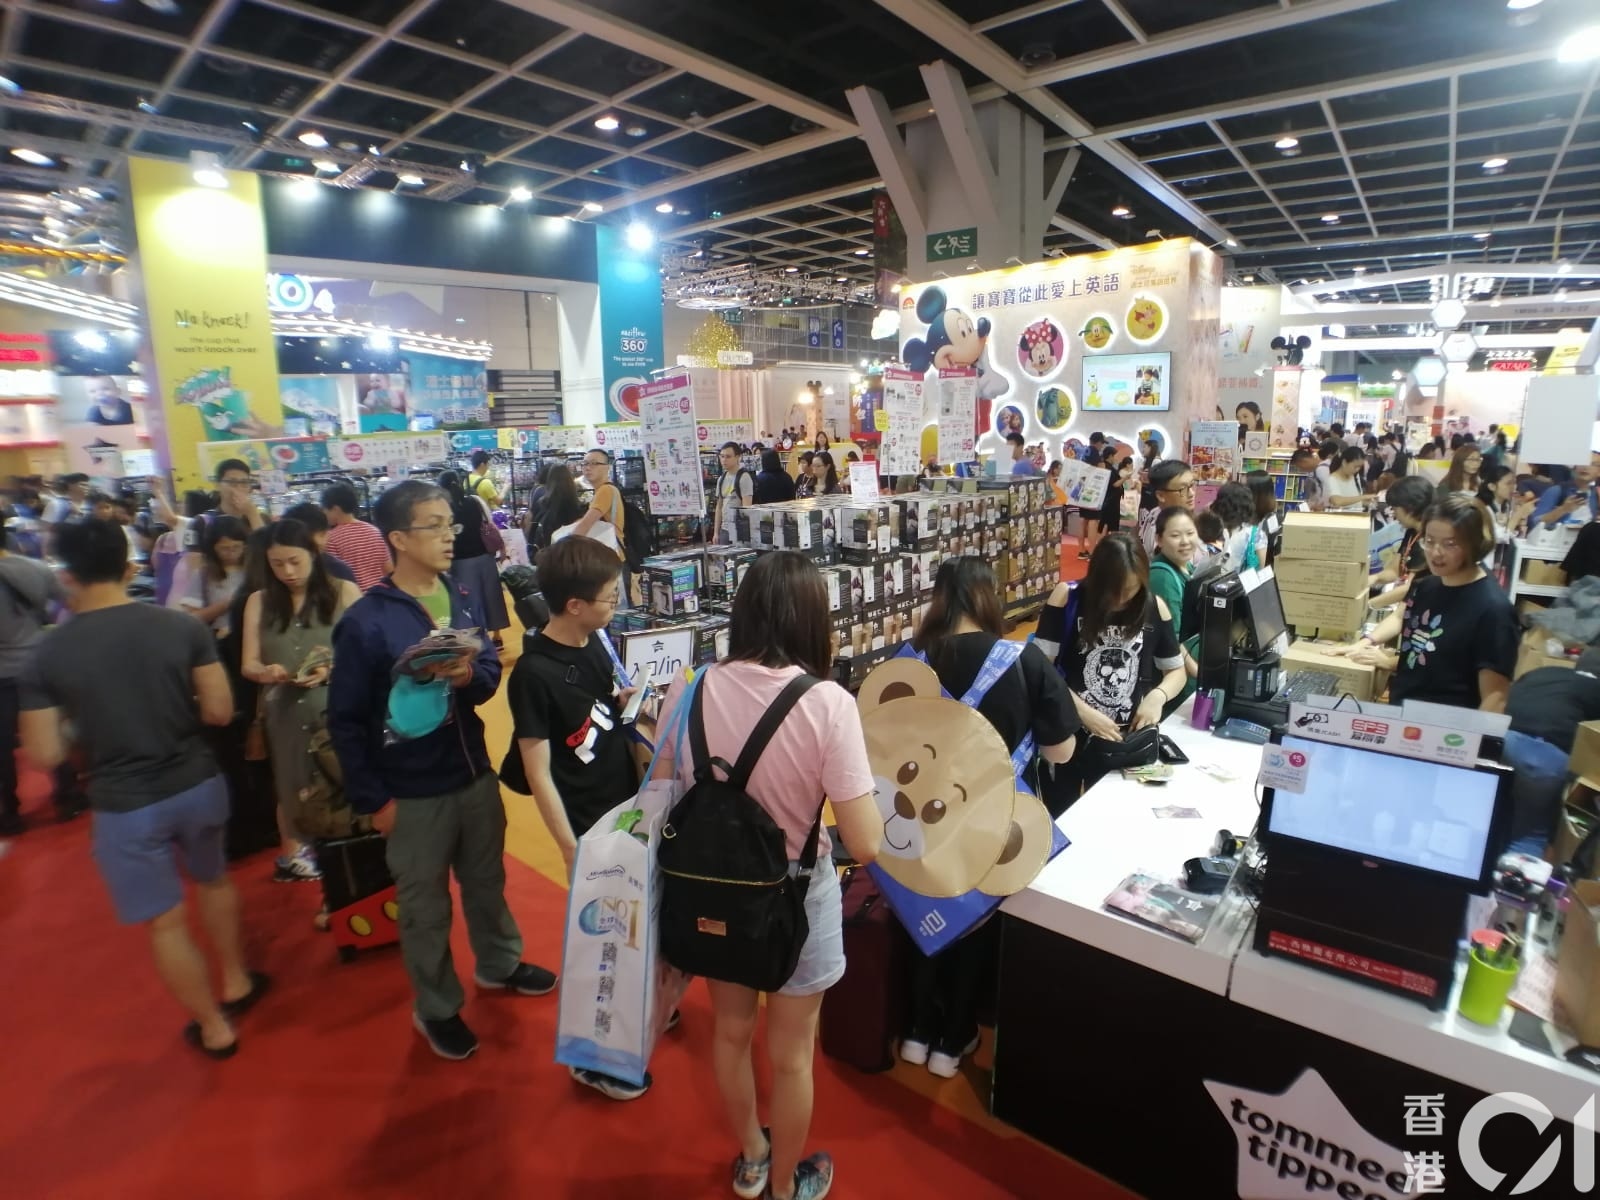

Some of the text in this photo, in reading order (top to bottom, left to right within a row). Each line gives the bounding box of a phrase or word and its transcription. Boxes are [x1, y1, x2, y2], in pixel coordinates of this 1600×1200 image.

[972, 272, 1120, 310] 讓寶寶從此愛上英語
[1230, 1098, 1412, 1194] tommee
